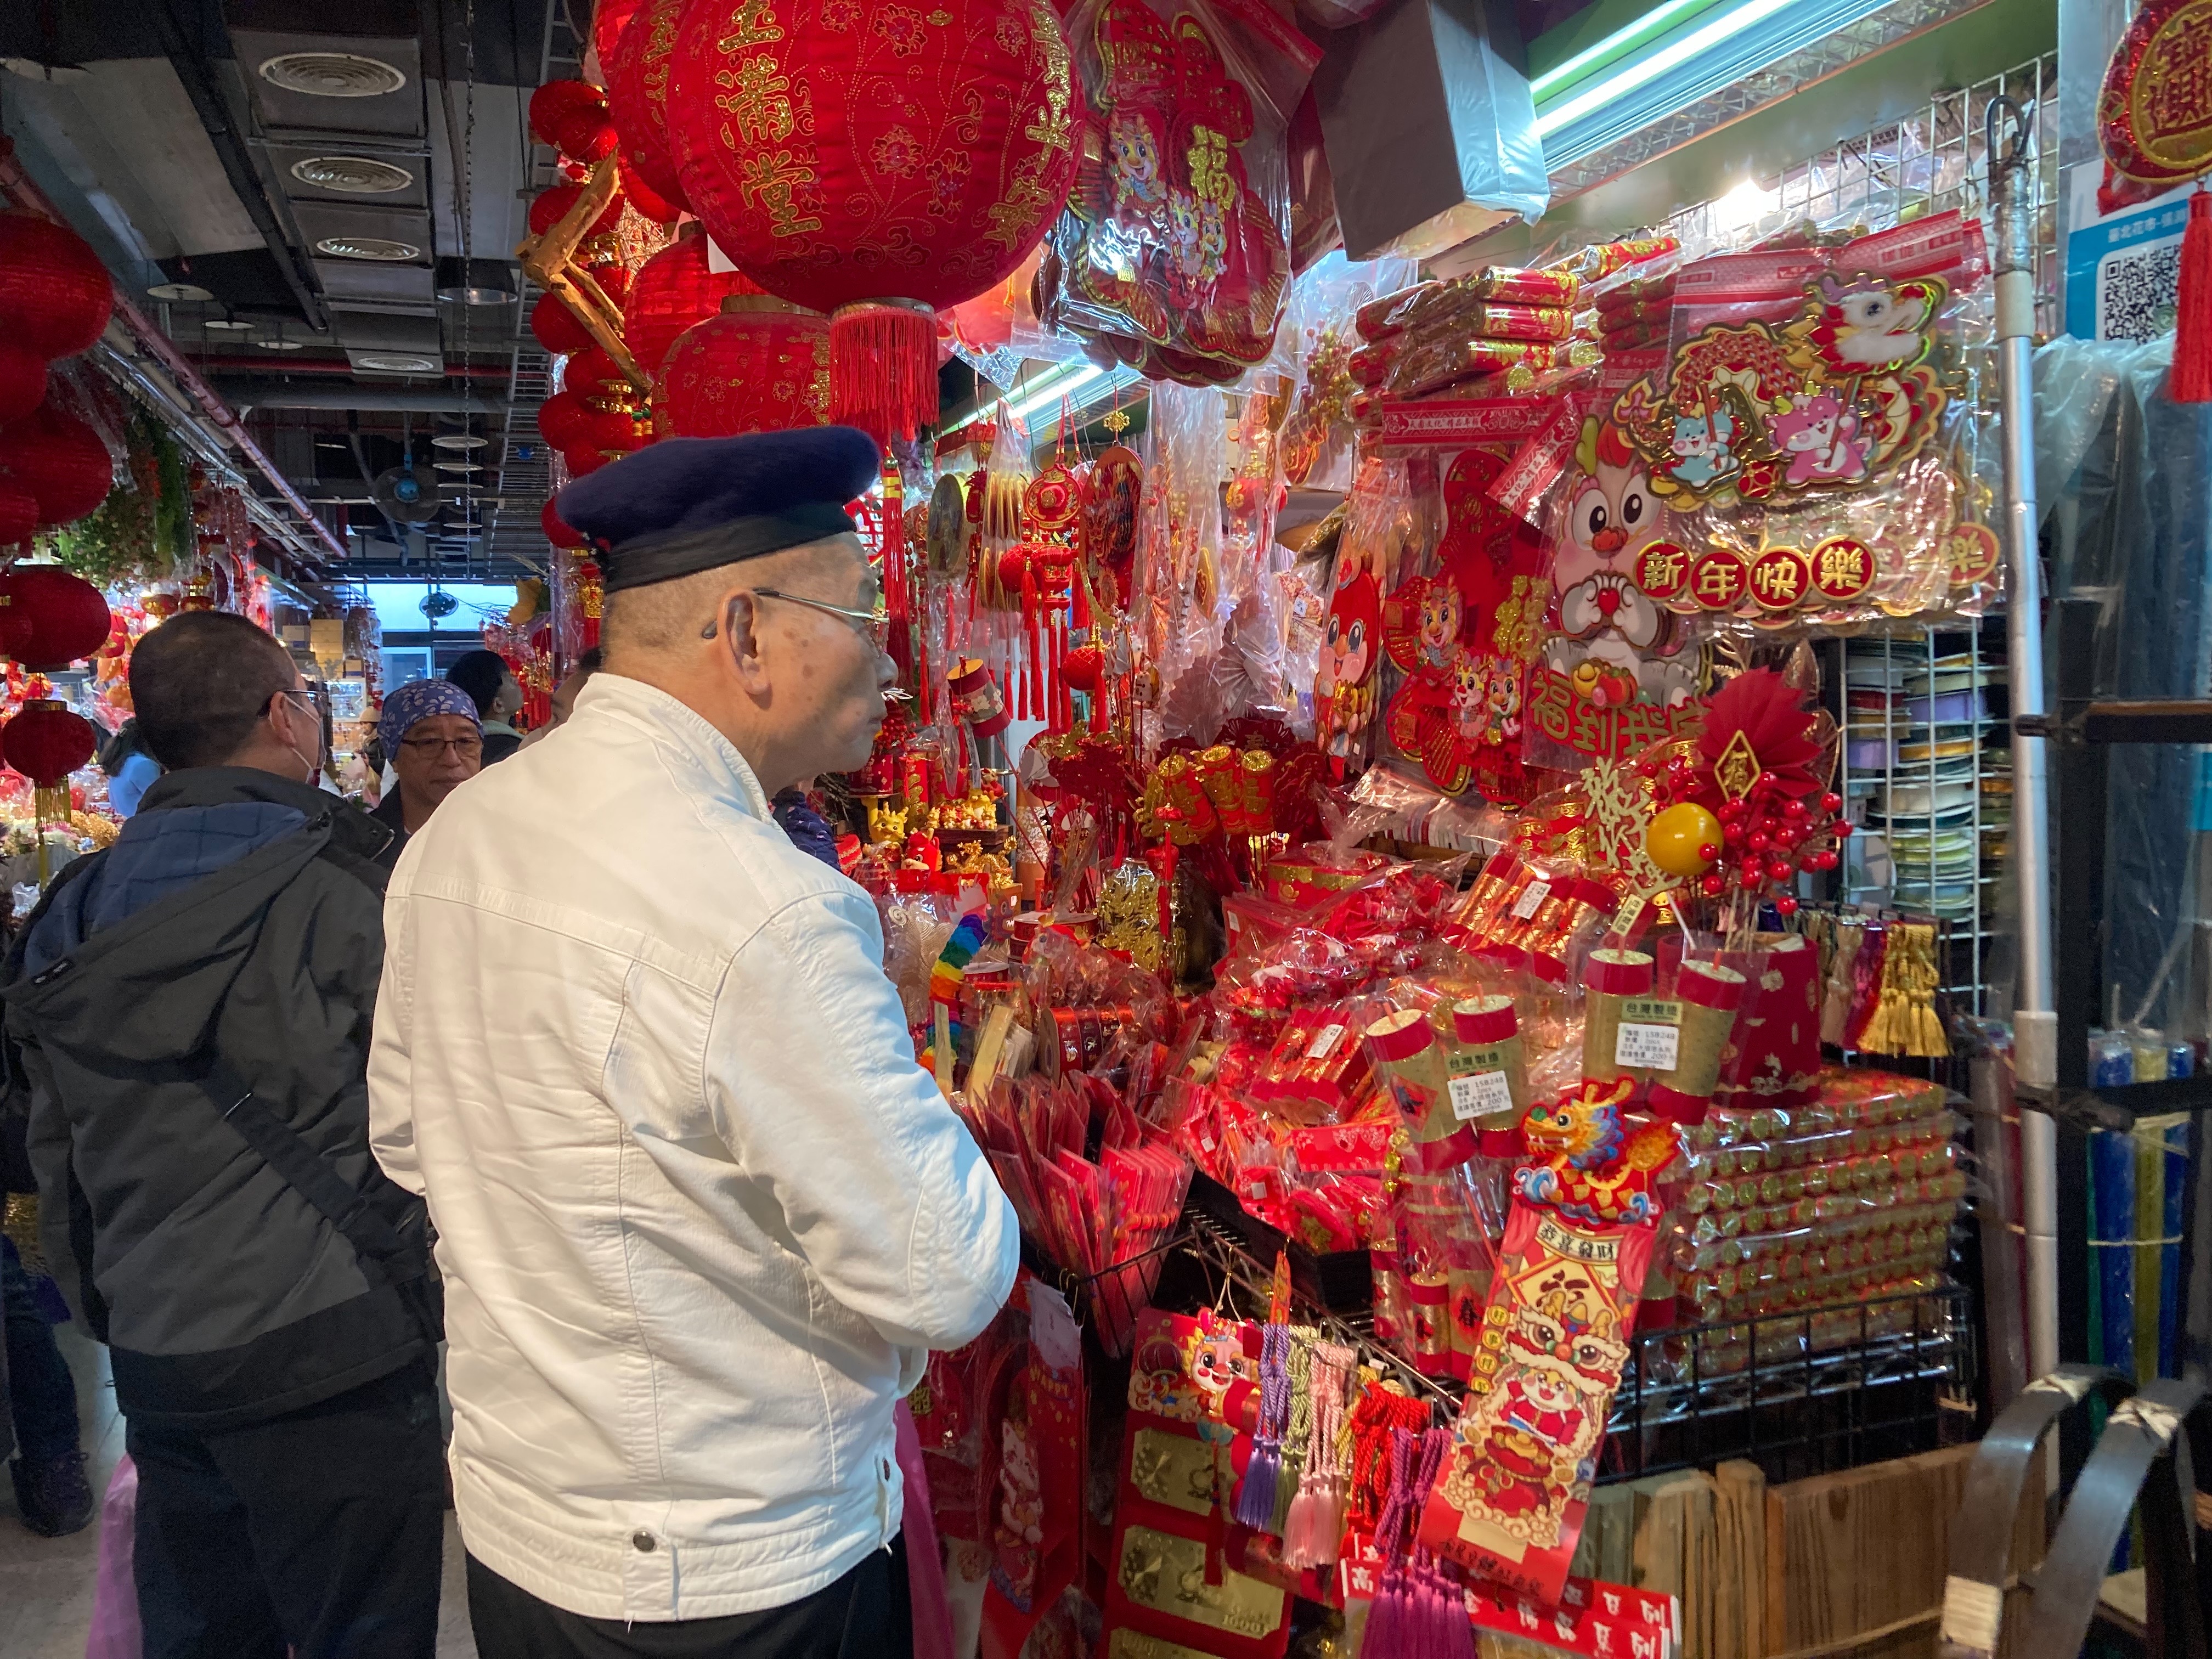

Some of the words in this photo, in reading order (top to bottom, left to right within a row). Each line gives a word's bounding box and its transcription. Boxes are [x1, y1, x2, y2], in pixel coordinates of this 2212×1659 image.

[1644, 550, 1865, 601] 新年快樂
[1539, 1224, 1614, 1260] 恭喜發財
